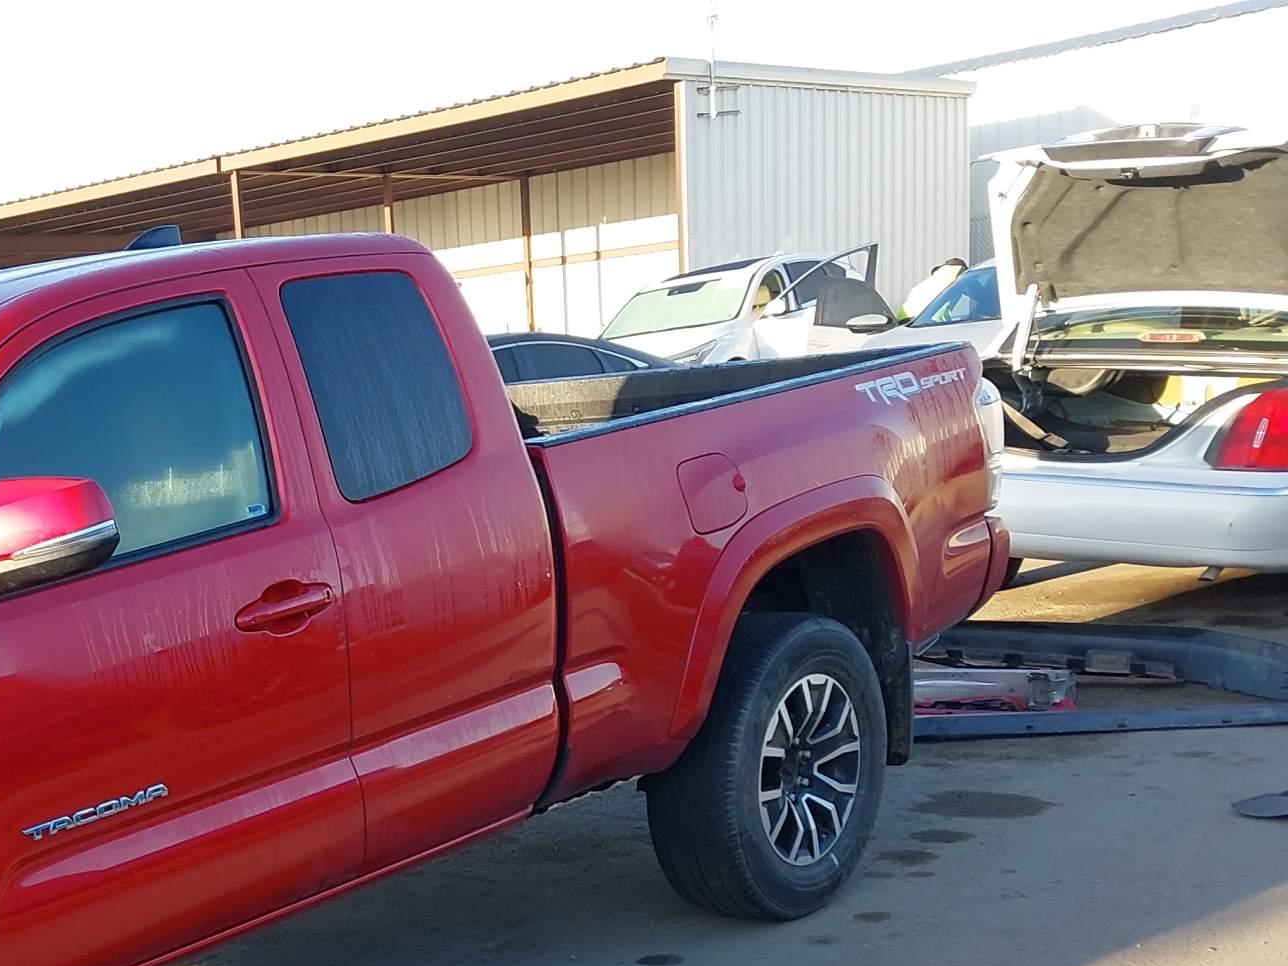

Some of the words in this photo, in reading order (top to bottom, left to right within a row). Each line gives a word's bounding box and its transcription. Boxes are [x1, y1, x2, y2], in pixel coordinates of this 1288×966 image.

[854, 371, 921, 407] TRD
[920, 367, 966, 390] SPORT
[21, 783, 169, 841] TACOMA
